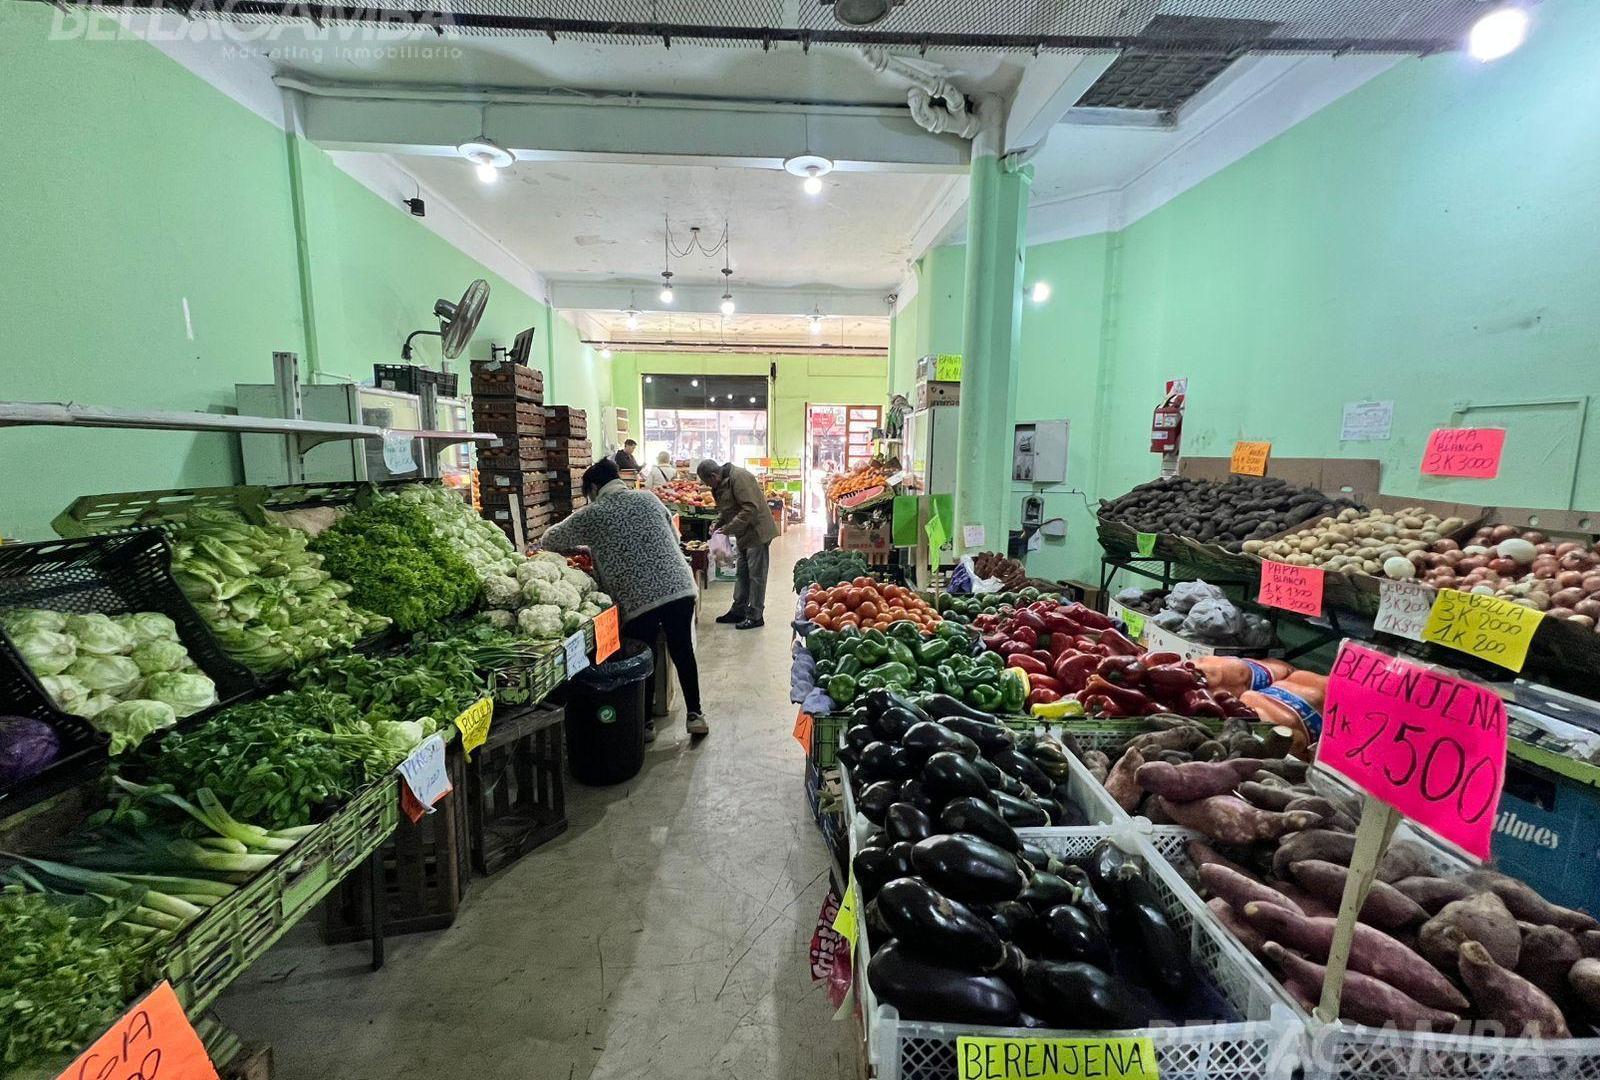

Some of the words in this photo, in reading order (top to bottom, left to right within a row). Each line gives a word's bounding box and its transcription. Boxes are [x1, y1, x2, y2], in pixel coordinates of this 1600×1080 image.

[1268, 562, 1299, 576] PAPA
[1273, 574, 1306, 585] BLANCA
[1443, 589, 1524, 621] CEBOLLA
[1458, 608, 1473, 627] K
[1333, 647, 1502, 737] BERENJENA
[1325, 702, 1338, 739] 1
[1345, 711, 1498, 824] 2500
[1491, 809, 1559, 850] ilmes
[964, 1042, 1146, 1080] BERENJENA
